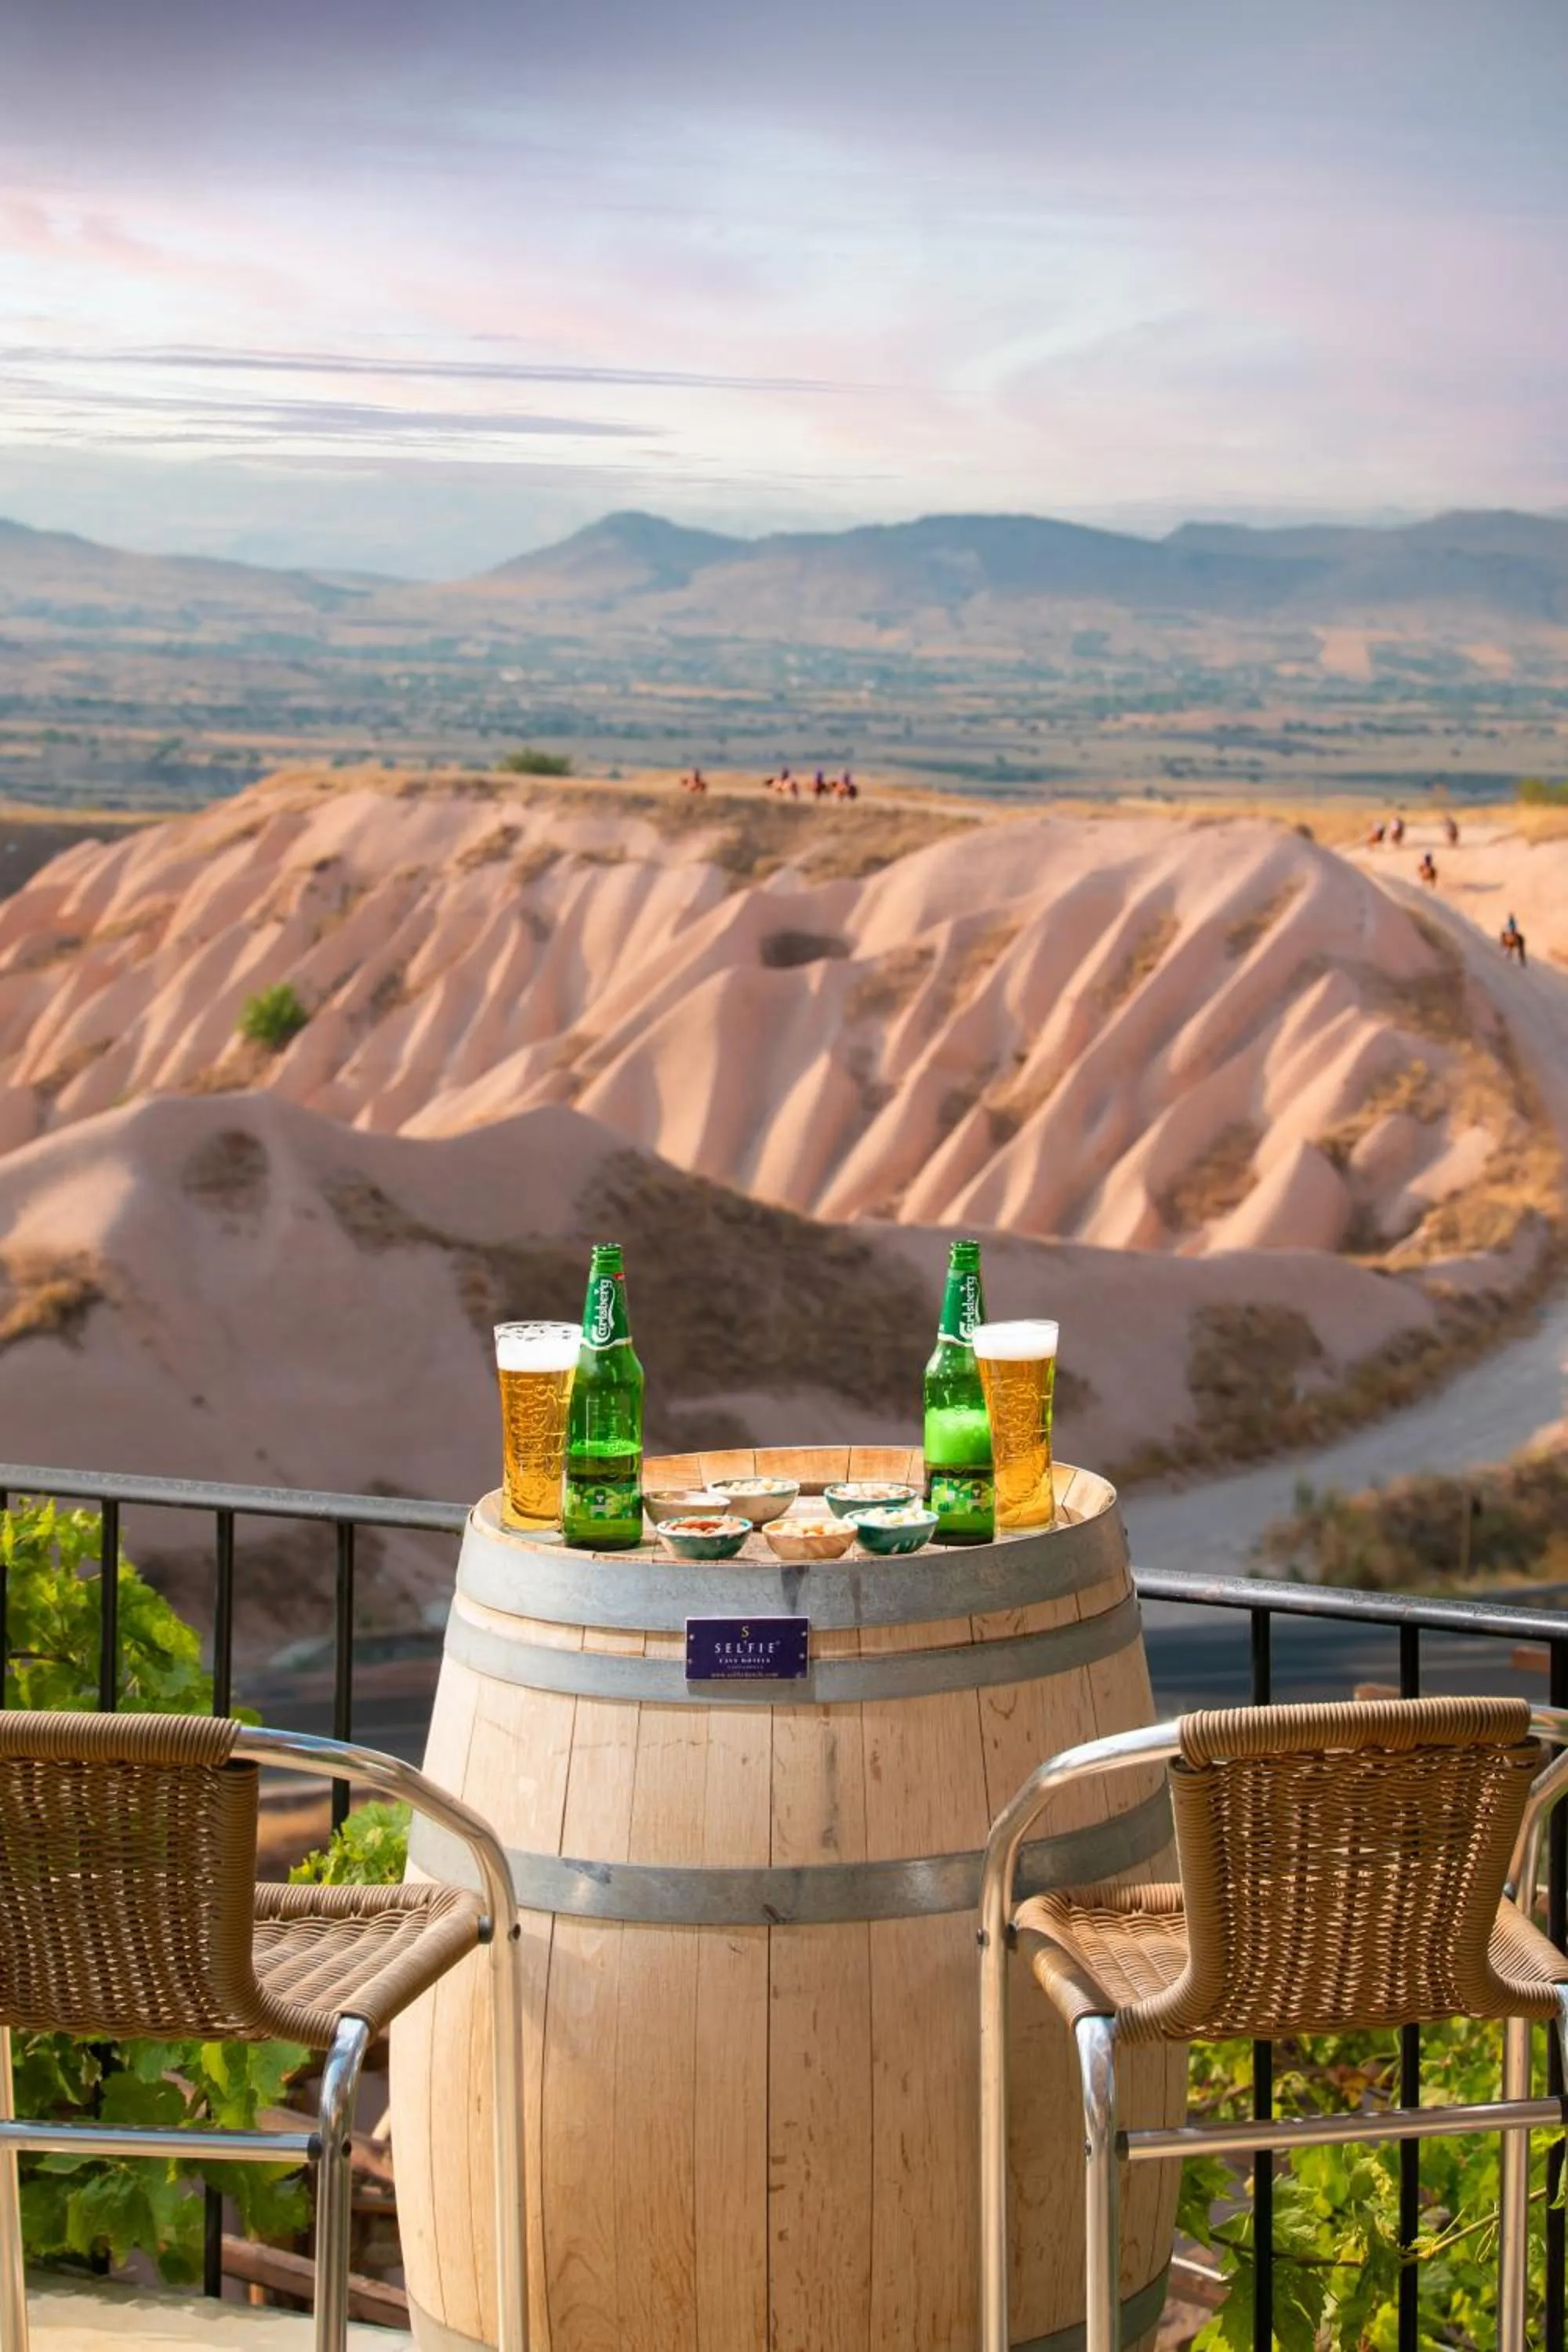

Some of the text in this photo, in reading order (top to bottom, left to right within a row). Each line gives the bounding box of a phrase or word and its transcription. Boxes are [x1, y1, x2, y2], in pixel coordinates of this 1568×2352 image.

[591, 1279, 614, 1343] Carlsberg
[959, 1276, 979, 1338] Carlsberg
[714, 1642, 775, 1653] SELFIE
[741, 1626, 750, 1637] S
